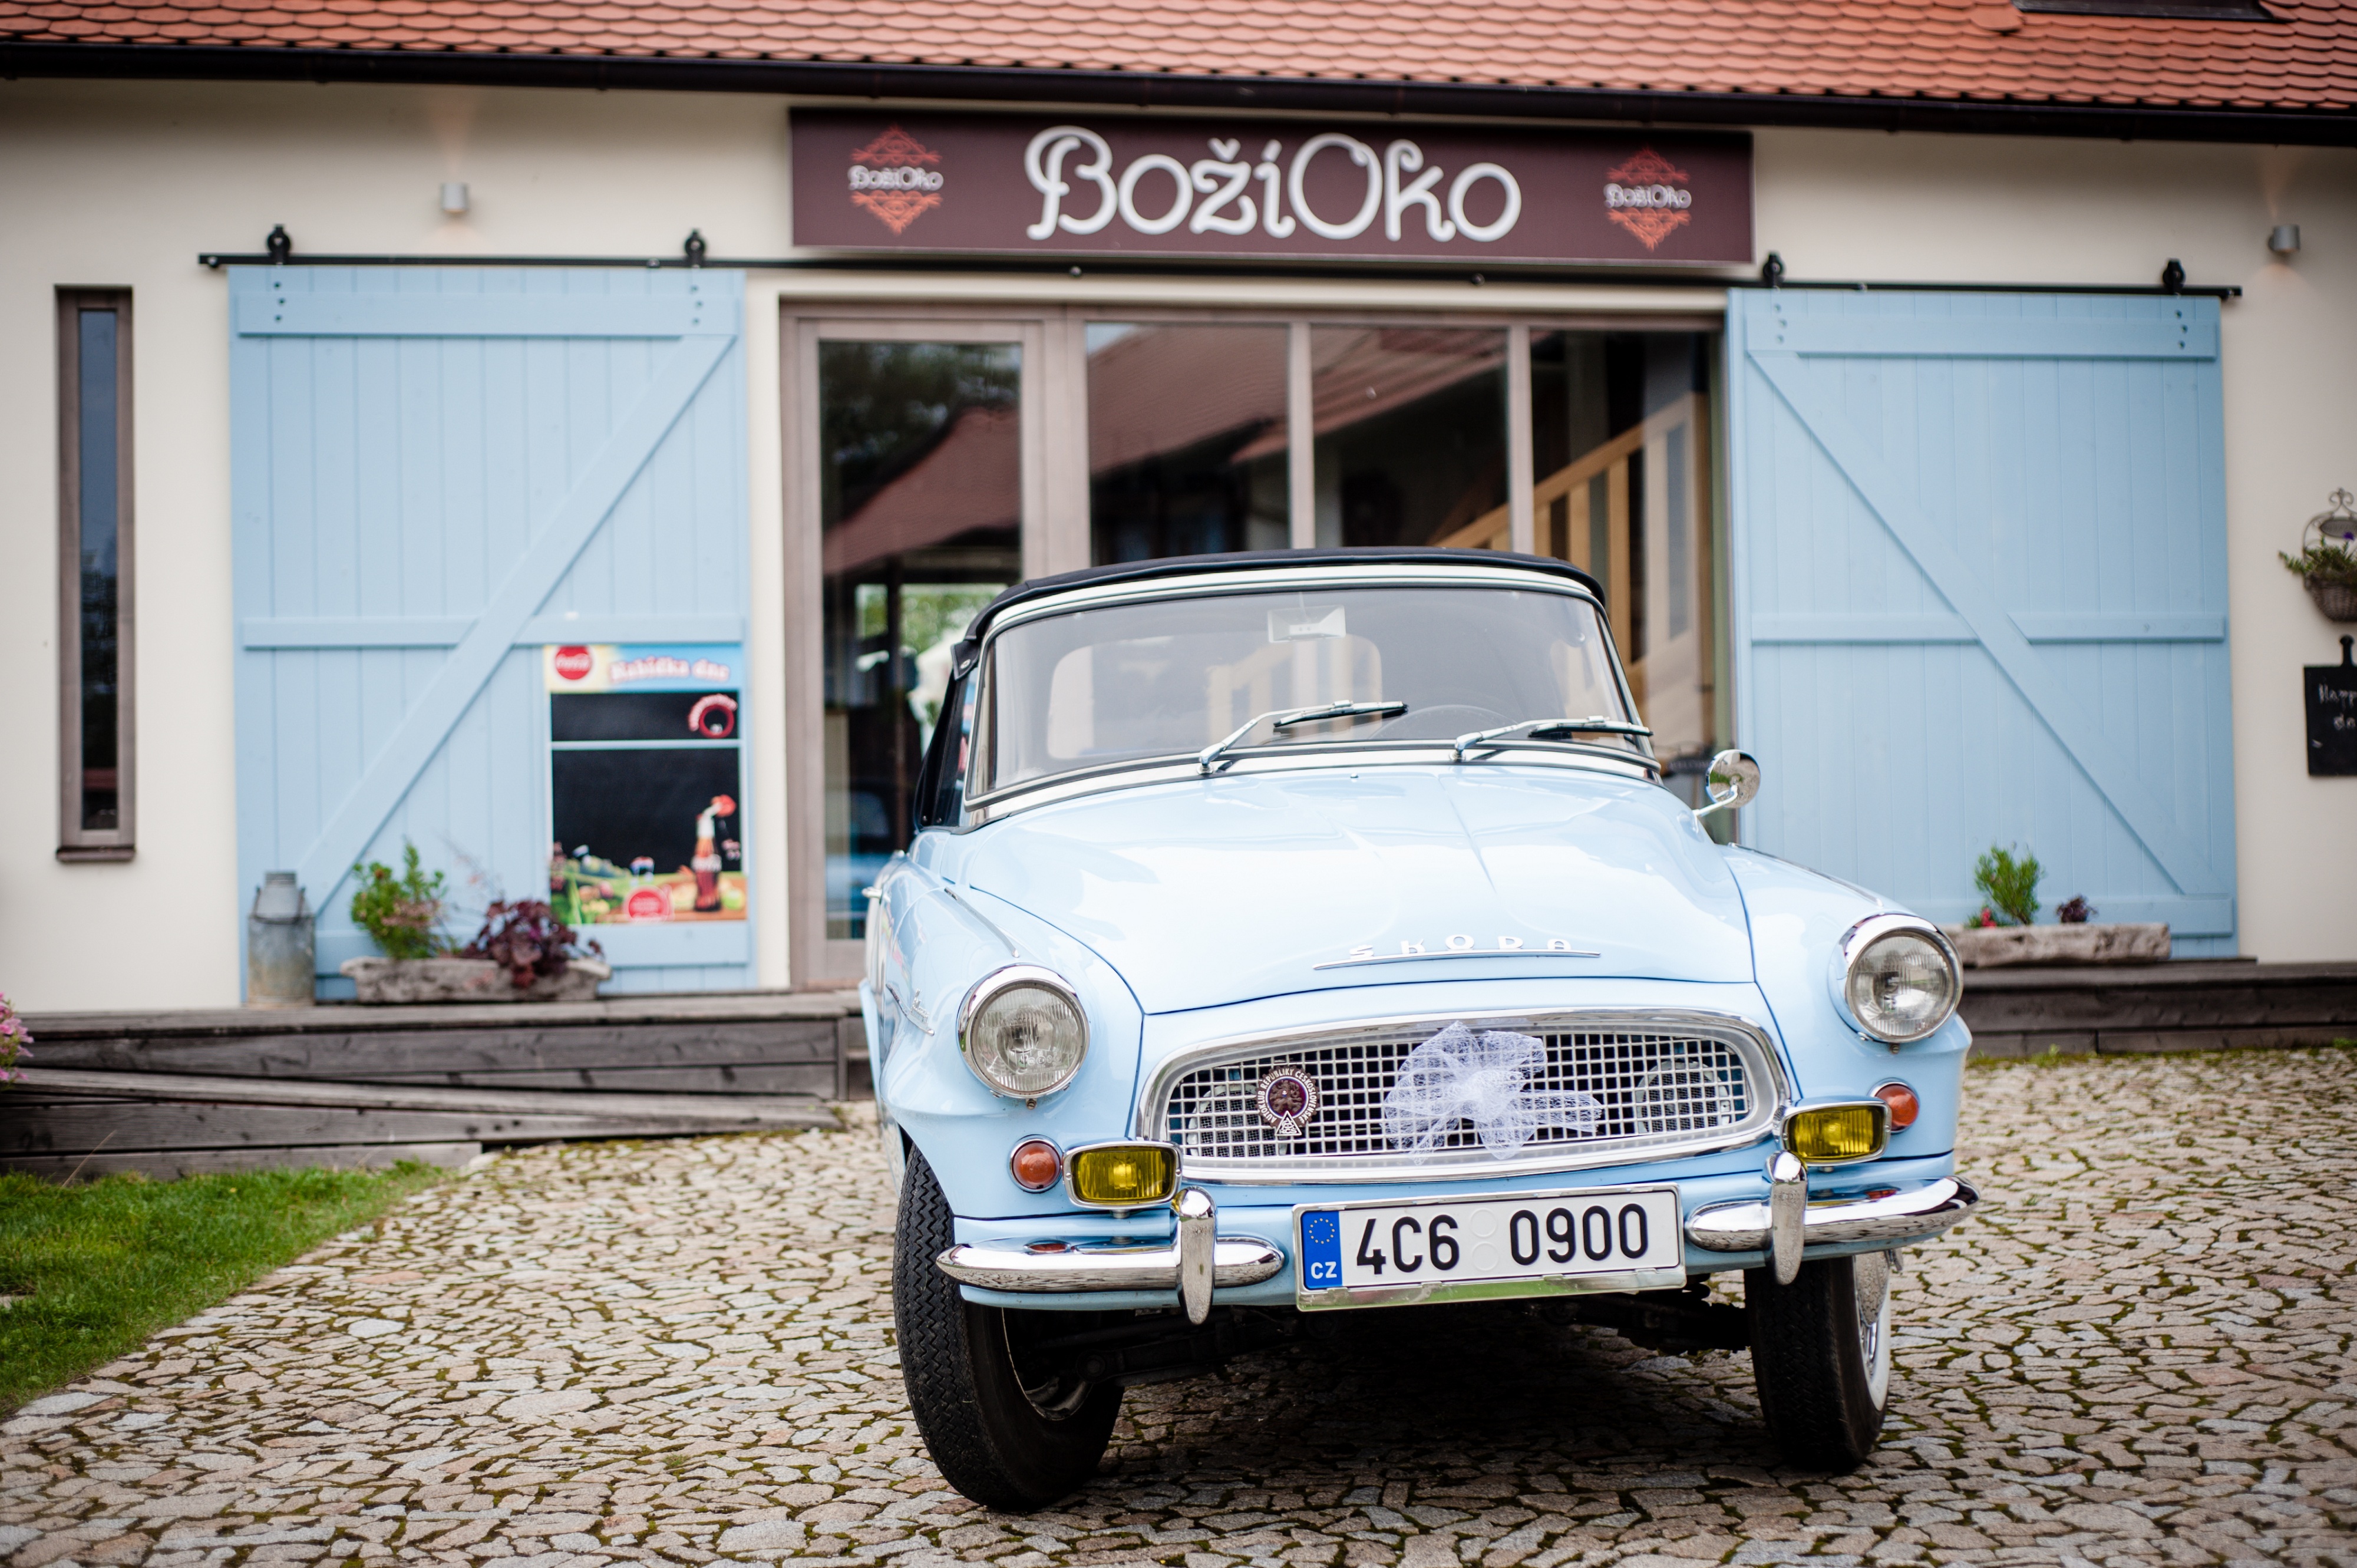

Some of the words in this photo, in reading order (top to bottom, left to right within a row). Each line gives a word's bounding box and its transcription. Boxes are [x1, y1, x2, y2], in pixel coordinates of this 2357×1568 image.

[1260, 1068, 1295, 1090] REPUBLIKY
[1257, 1090, 1277, 1123] AUTOKLUB
[1356, 1214, 1460, 1275] 4C6
[1510, 1203, 1648, 1266] 0900
[1310, 1261, 1338, 1279] CZ
